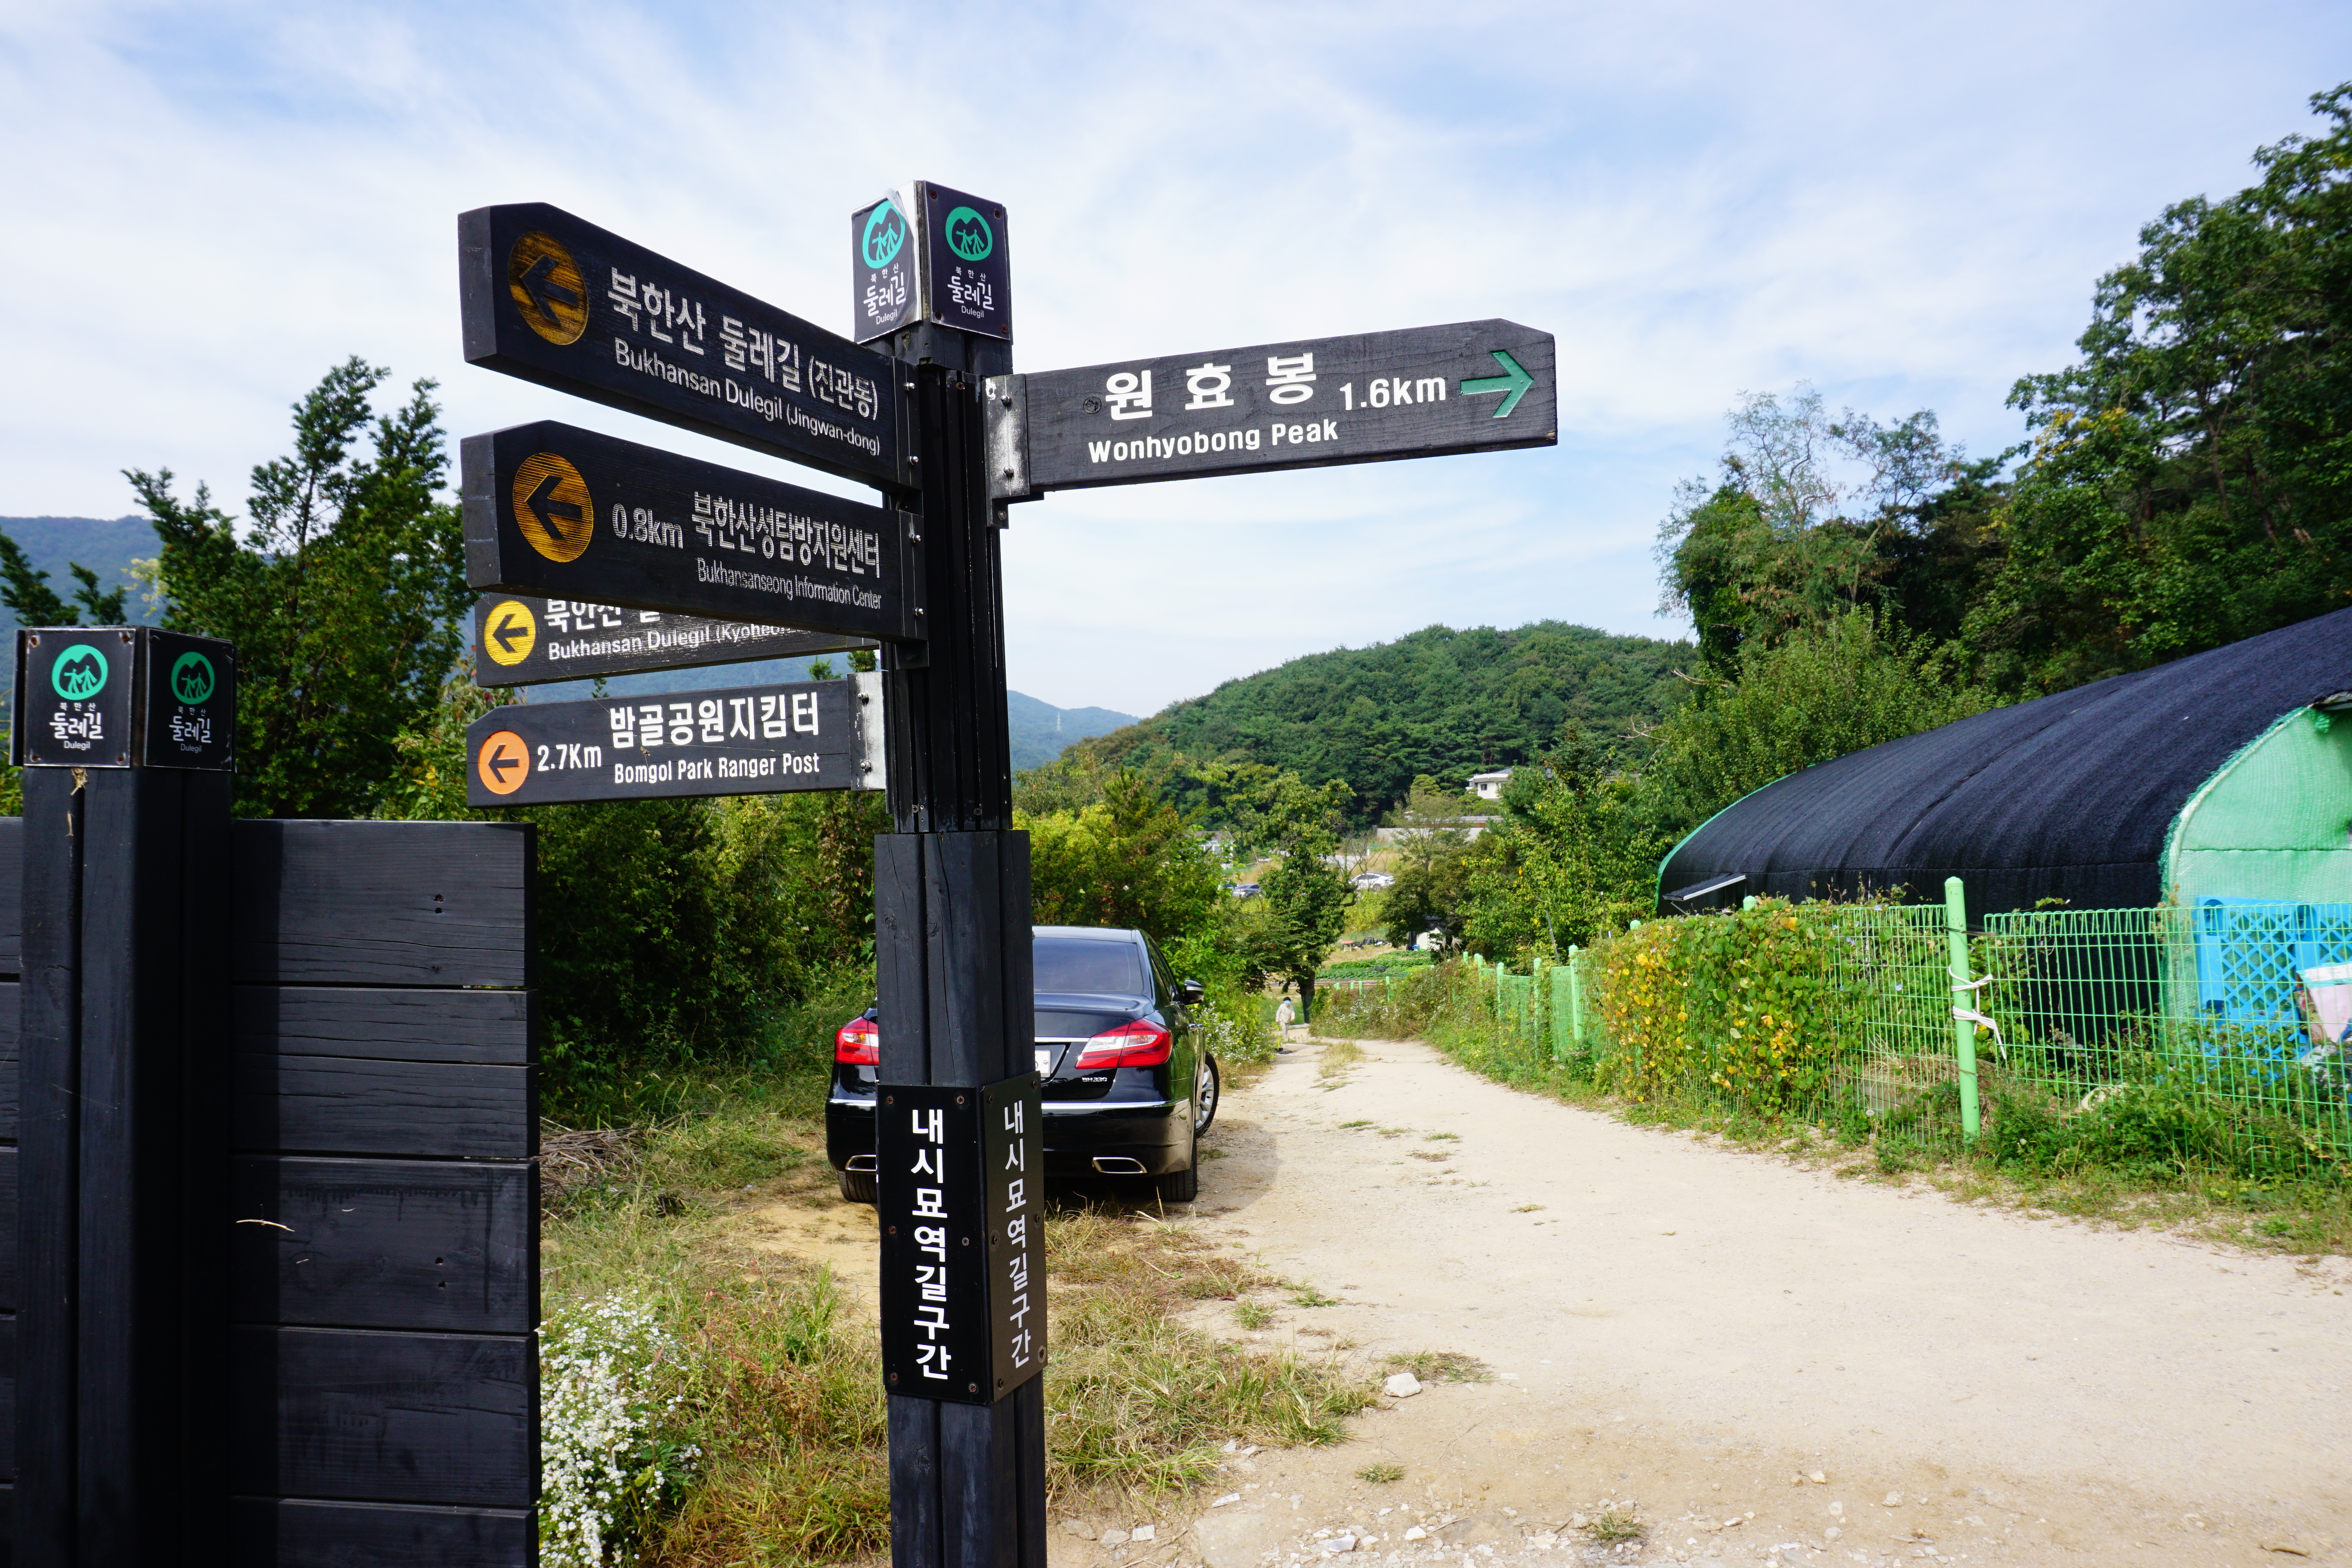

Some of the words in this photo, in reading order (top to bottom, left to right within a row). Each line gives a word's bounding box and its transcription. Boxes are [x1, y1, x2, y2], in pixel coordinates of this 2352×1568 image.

[864, 272, 907, 317] 둘레길
[947, 276, 995, 310] 둘레길
[876, 309, 898, 325] Dulegil
[962, 306, 985, 318] Dulegil
[608, 267, 706, 355] 북한산
[719, 314, 800, 392] 둘레길
[808, 355, 877, 420] (진관동)
[615, 337, 721, 398] Bukhansan
[726, 378, 782, 421] Dulegil
[787, 403, 880, 456] (Jingwan-dong)
[1340, 376, 1446, 410] 1.6km
[1089, 428, 1260, 463] Wonhyobong
[1272, 419, 1338, 446] Peak
[612, 503, 683, 548] 0.8km
[691, 491, 880, 578] 북한산성탐방지원센터
[697, 557, 793, 600] Bukhansanseong
[795, 574, 851, 604] Information
[852, 584, 881, 609] Center
[549, 637, 642, 660] Bukhansan
[647, 625, 710, 648] Dulegil
[49, 712, 103, 739] 둘레길
[169, 715, 212, 743] 둘레길
[610, 691, 818, 748] 밤골공원지킴터
[64, 740, 91, 750] Dulegil
[180, 743, 202, 753] Dulegil
[537, 743, 601, 771] 2.7Km
[614, 760, 672, 784] Bomgol
[678, 758, 712, 780] Park
[718, 757, 776, 778] Ranger
[782, 752, 819, 774] Post
